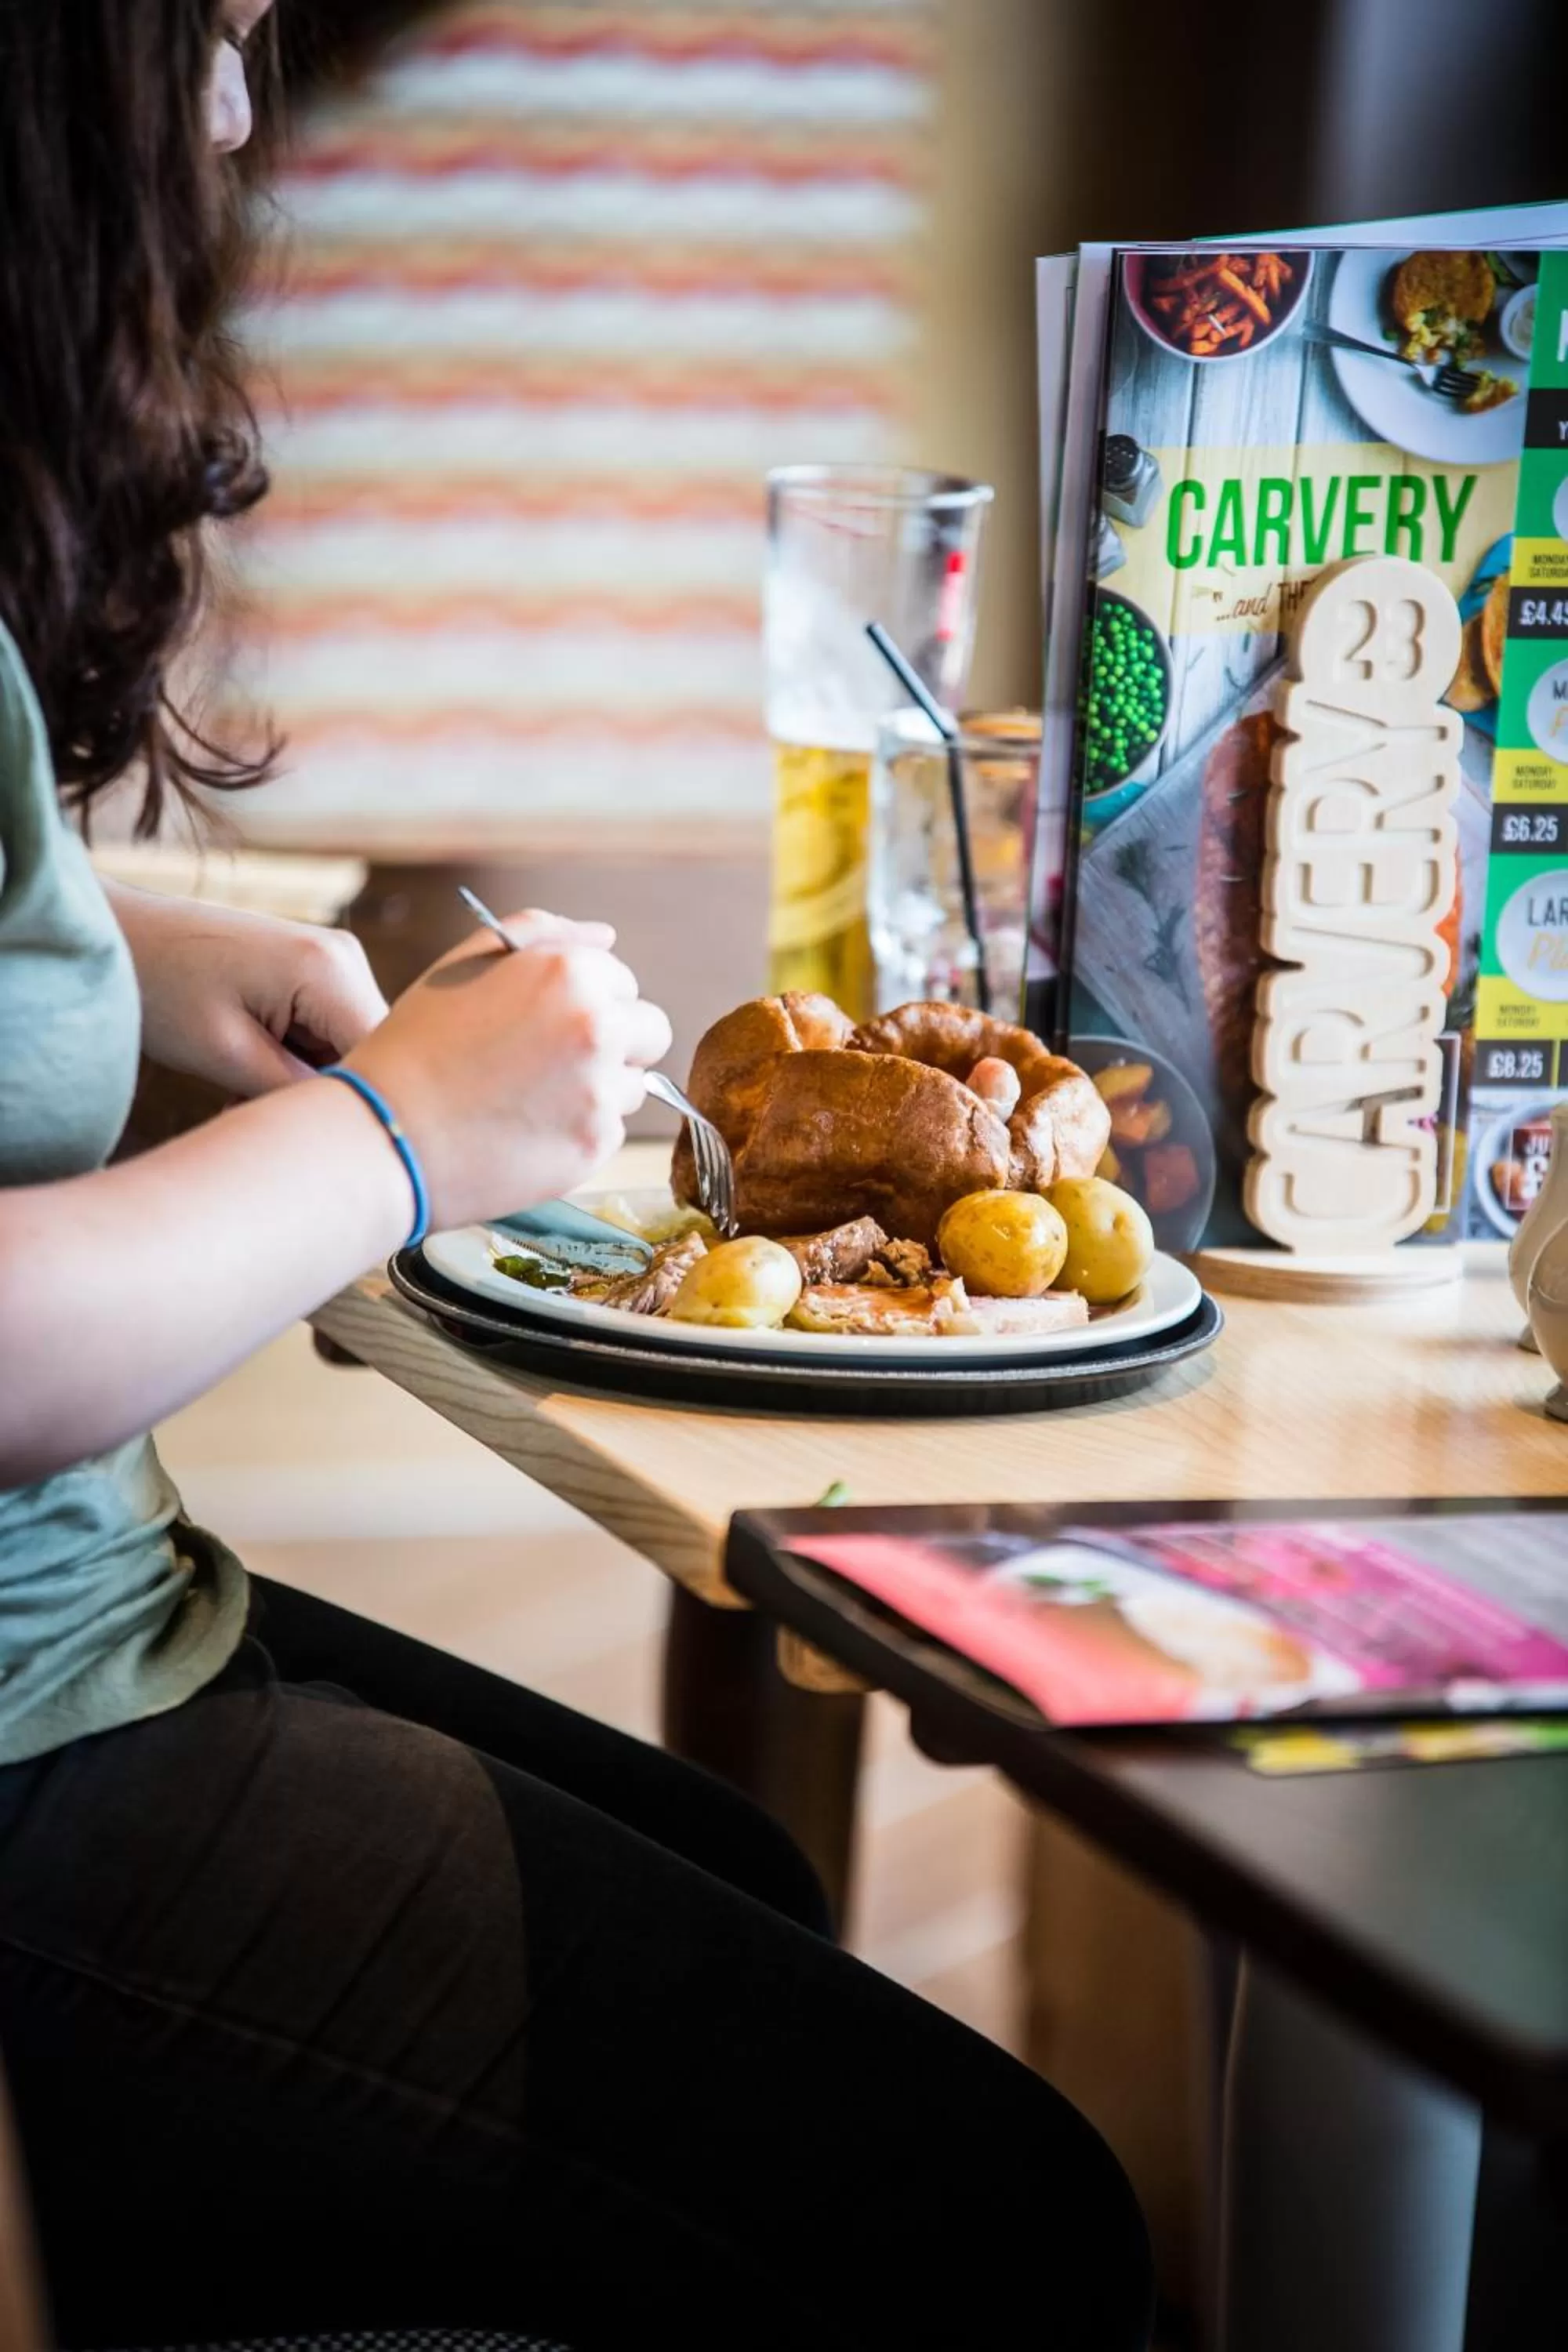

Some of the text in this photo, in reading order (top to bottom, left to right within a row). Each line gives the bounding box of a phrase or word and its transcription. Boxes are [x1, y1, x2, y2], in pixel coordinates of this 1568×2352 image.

[1165, 474, 1479, 571] CARVERY
[1333, 598, 1426, 681] 23
[1502, 814, 1558, 842] £6.25
[1279, 698, 1449, 1225] CARVERY
[1487, 1051, 1544, 1079] £8.25
